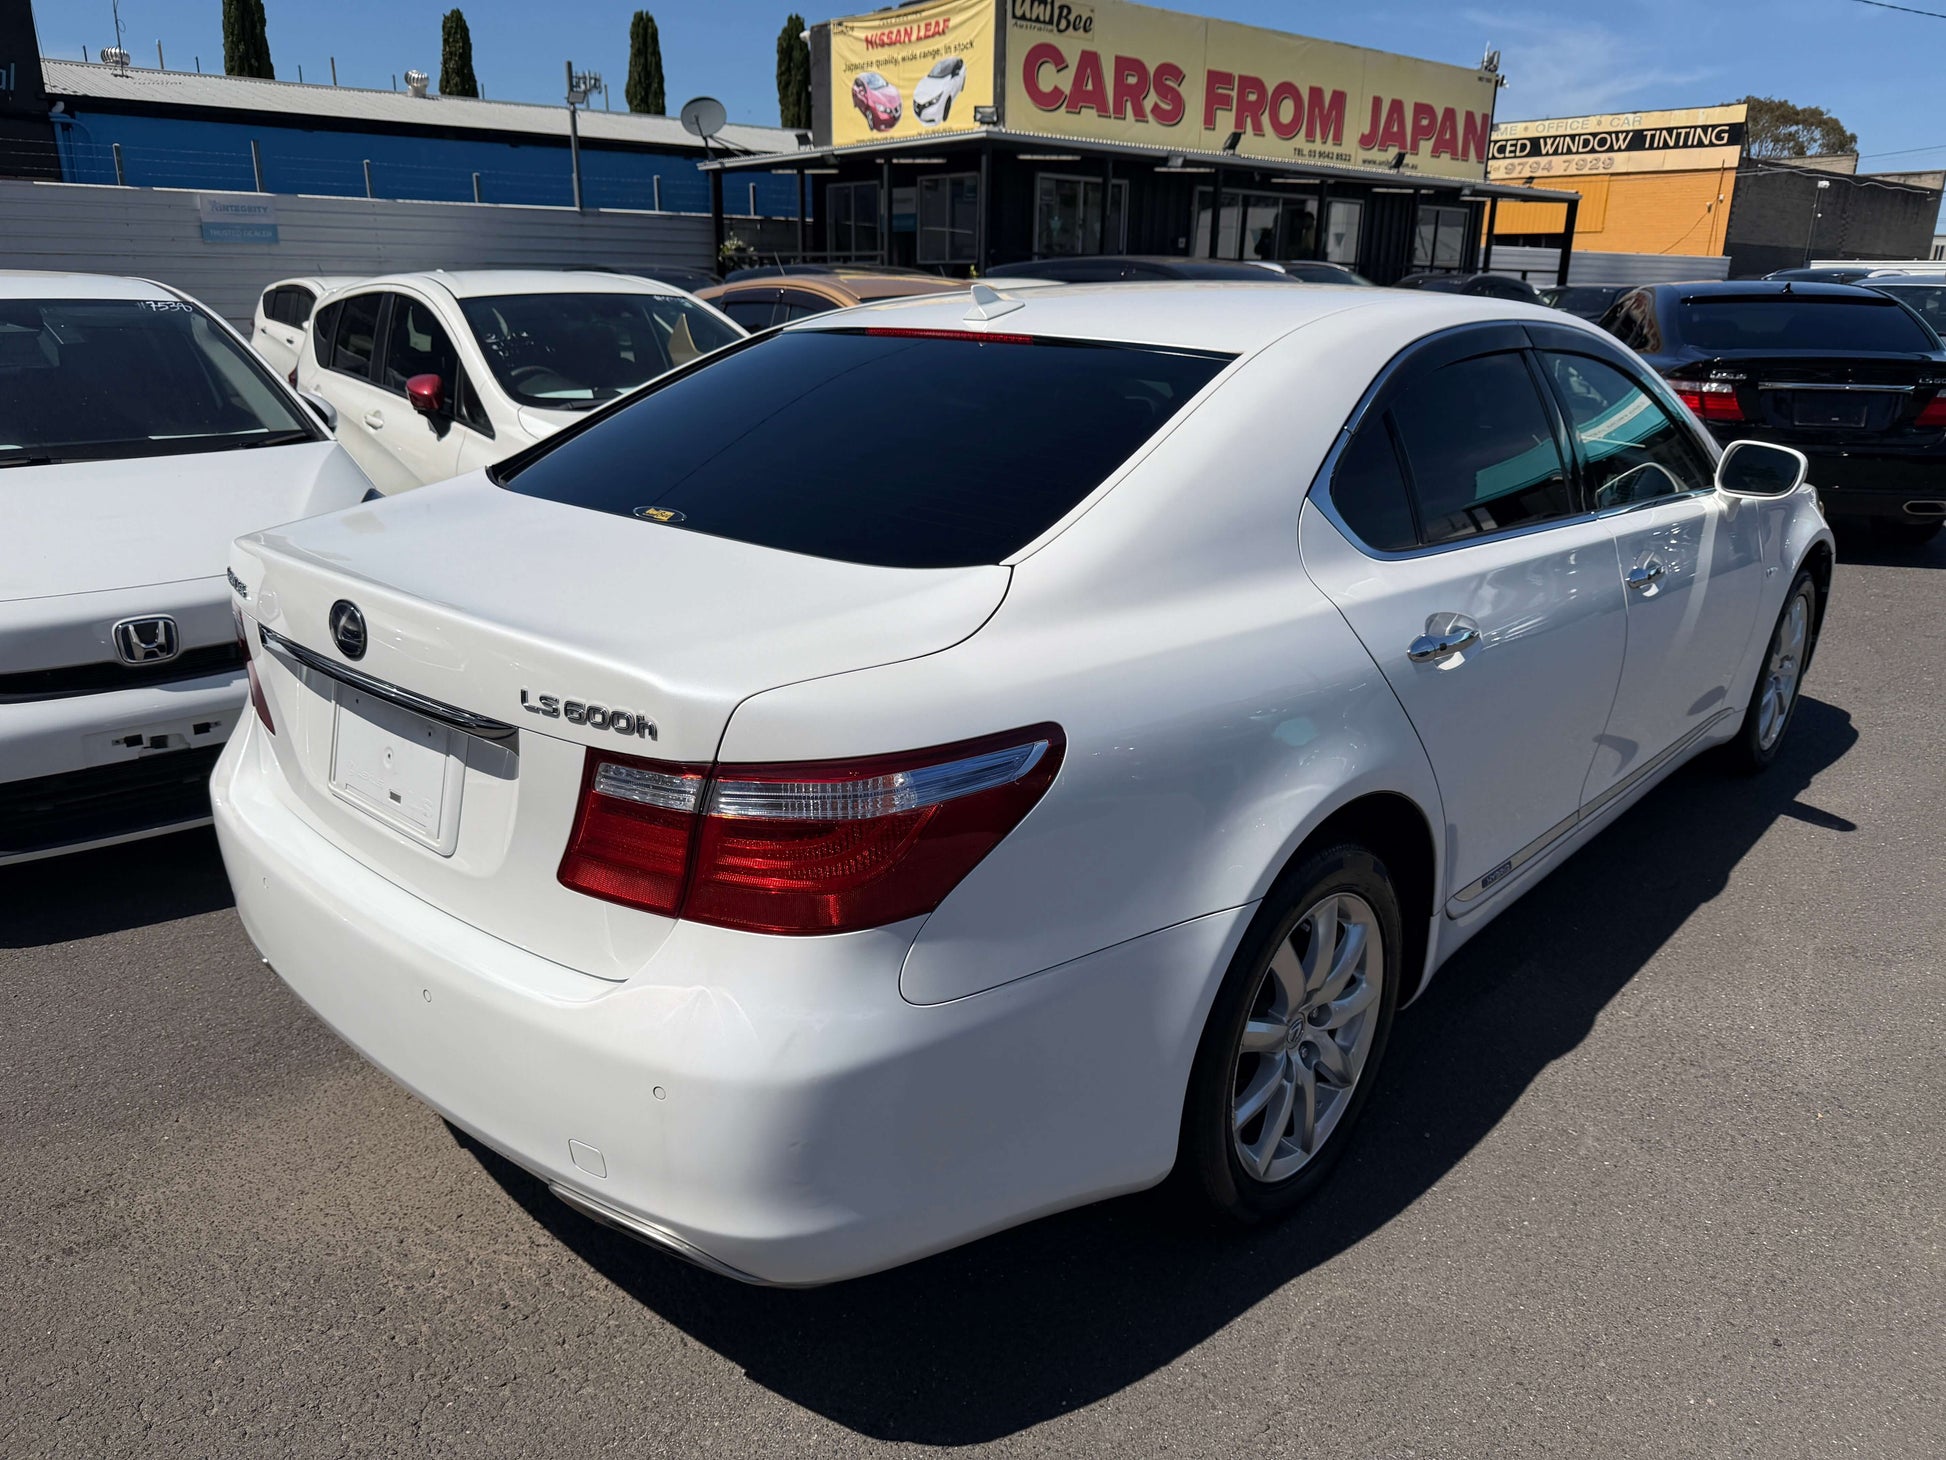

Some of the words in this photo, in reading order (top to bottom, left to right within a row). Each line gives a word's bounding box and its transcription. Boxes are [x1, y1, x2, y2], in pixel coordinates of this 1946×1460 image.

[864, 25, 913, 51] NISSAN
[916, 17, 951, 41] LEAF
[1012, 21, 1055, 33] Australia
[843, 59, 873, 73] Japanese
[901, 50, 918, 63] wide
[953, 40, 975, 52] stock
[1022, 42, 1186, 126] CARS
[1203, 68, 1348, 146] FROM
[1358, 95, 1490, 164] JAPAN
[1535, 118, 1590, 135] OFFICE
[1609, 115, 1643, 128] CAR
[1308, 149, 1317, 158] 03
[1539, 131, 1633, 156] WINDOW
[1643, 126, 1730, 149] TINTING
[1504, 158, 1554, 175] 9794
[1562, 156, 1615, 172] 7929
